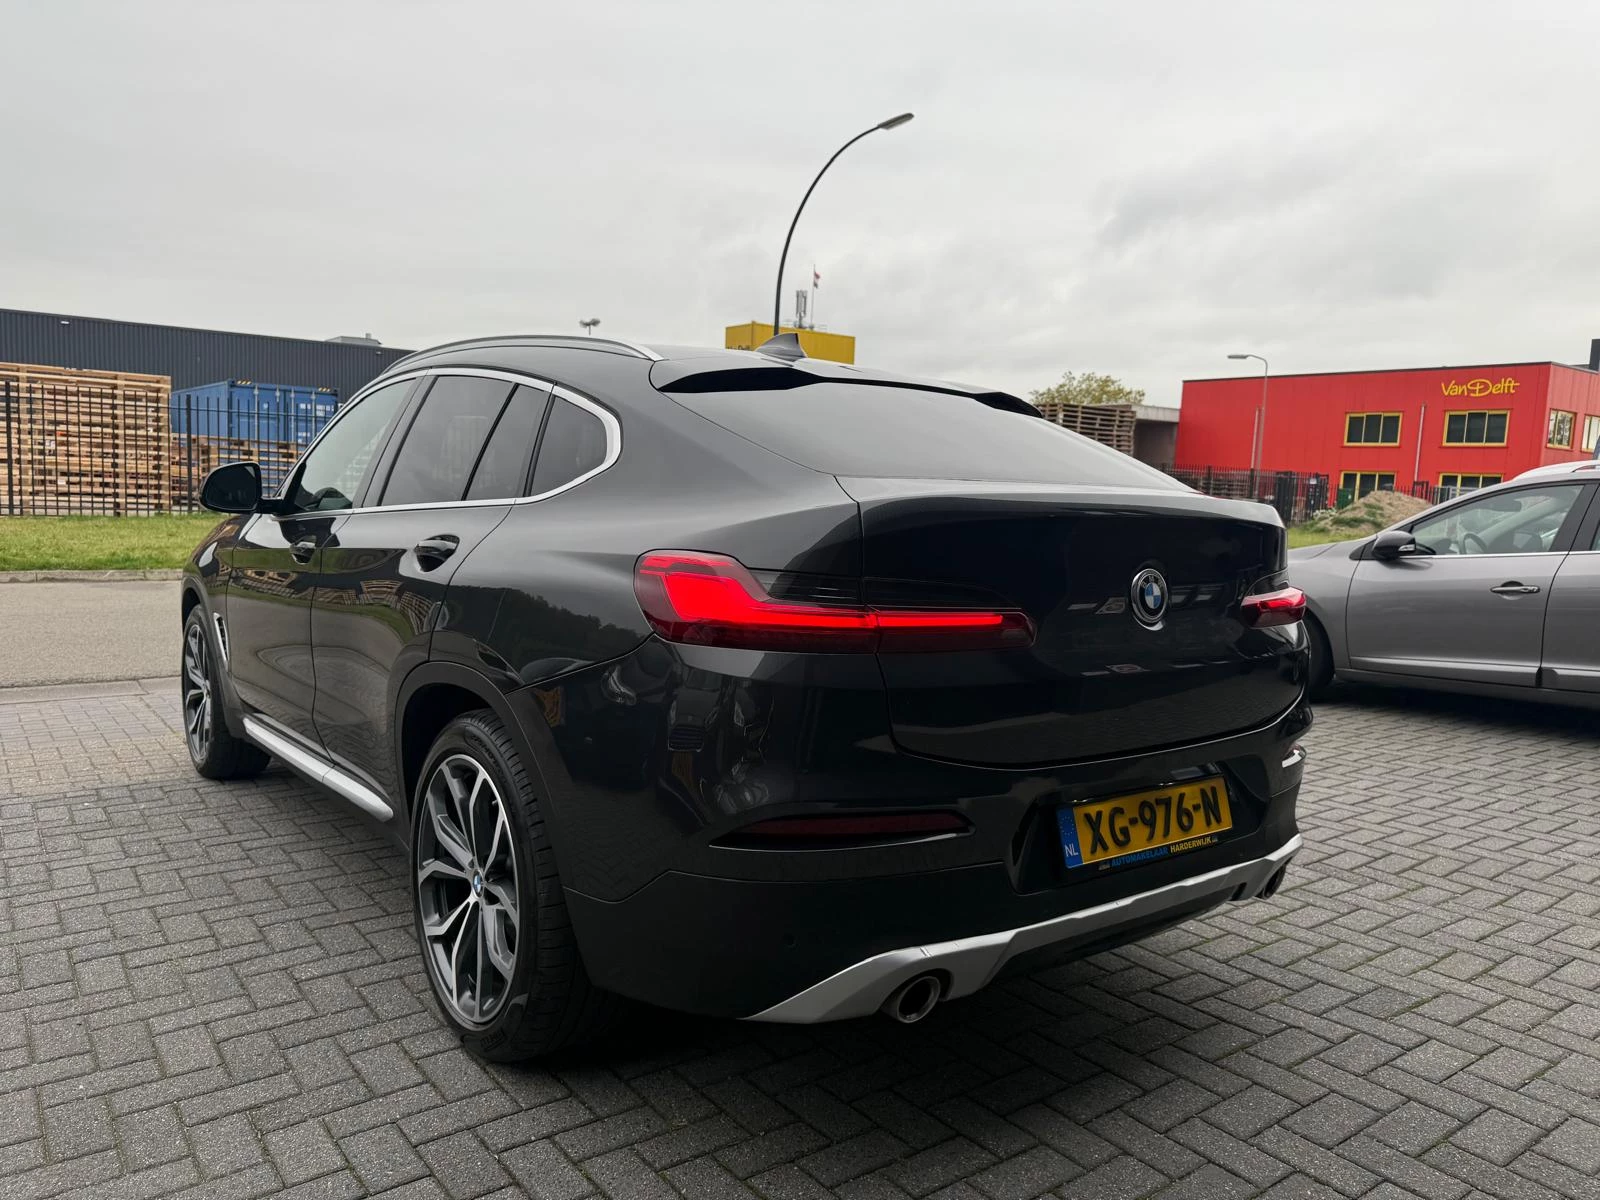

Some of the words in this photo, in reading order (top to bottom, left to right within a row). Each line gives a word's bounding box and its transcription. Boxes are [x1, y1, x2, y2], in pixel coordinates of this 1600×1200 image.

[1083, 785, 1222, 855] XG-976-N
[1064, 844, 1079, 857] NL
[1111, 847, 1169, 867] AUTOMAKELAAR
[1170, 836, 1212, 854] HARDERWIJK
